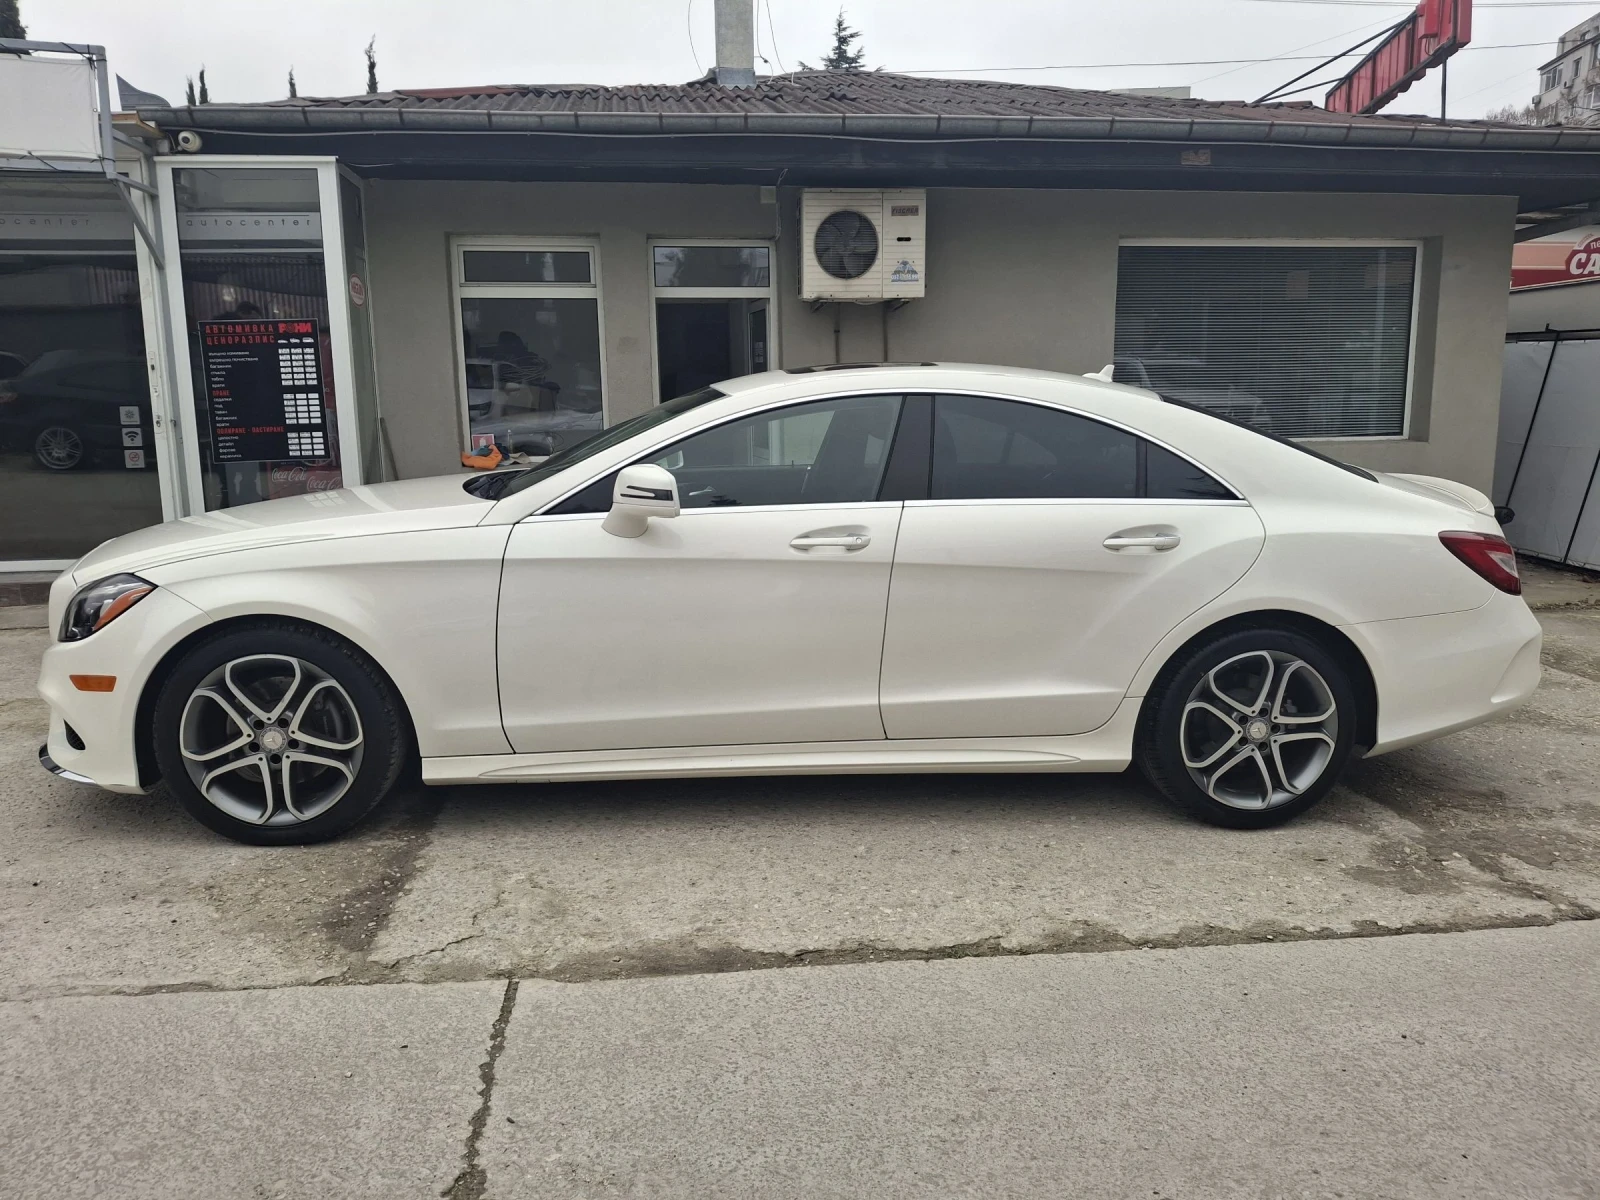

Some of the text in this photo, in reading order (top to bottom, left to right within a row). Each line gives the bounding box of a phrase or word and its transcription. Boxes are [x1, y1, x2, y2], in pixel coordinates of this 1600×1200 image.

[186, 217, 311, 227] autocenter
[206, 324, 274, 334] АВТОМИВКА
[206, 336, 275, 346] ЦЕНОРАЗПИС
